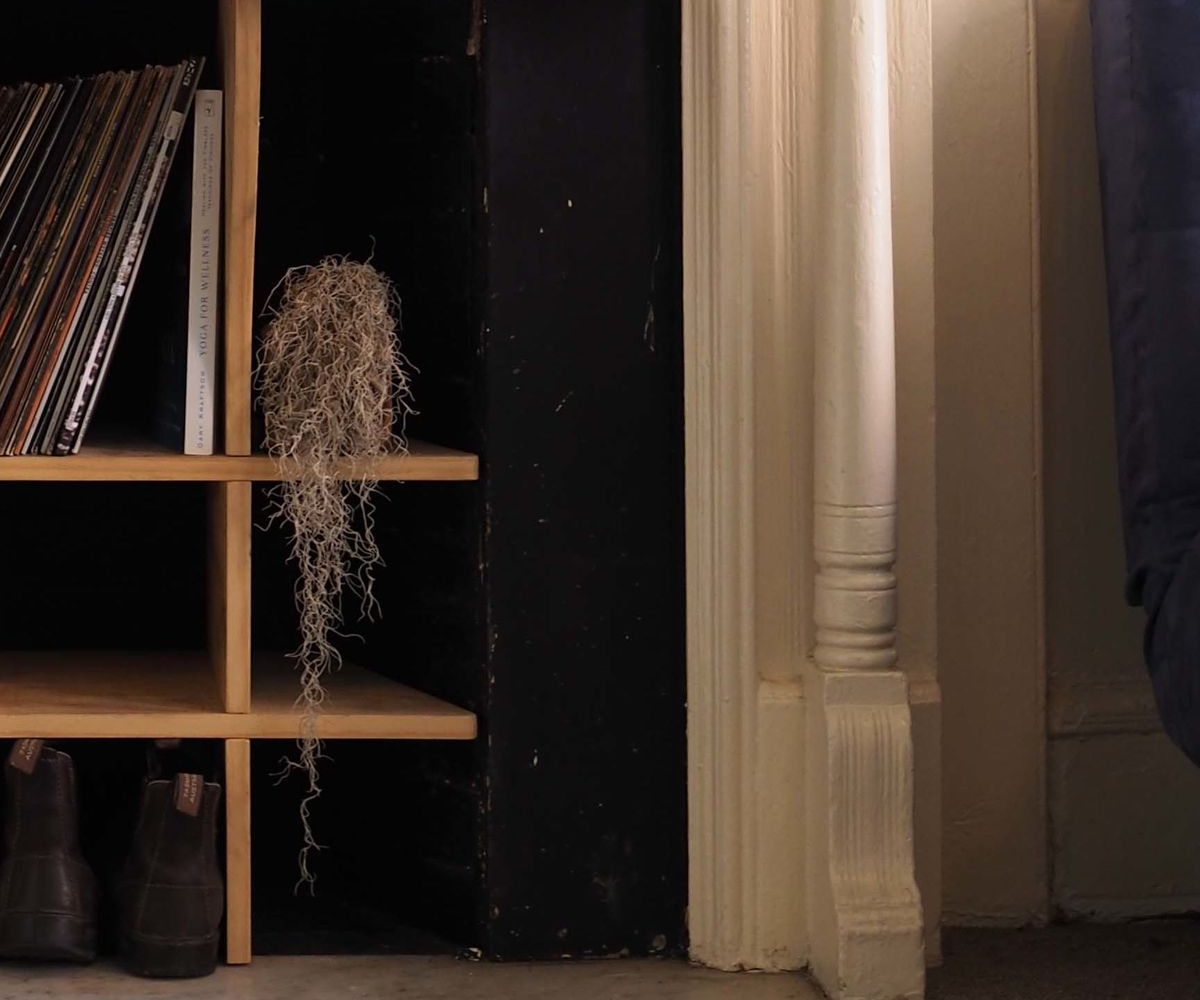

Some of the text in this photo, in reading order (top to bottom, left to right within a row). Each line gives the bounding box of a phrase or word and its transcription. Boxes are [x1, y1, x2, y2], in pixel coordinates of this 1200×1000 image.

[198, 228, 210, 358] YOGA FOR WELLNESS
